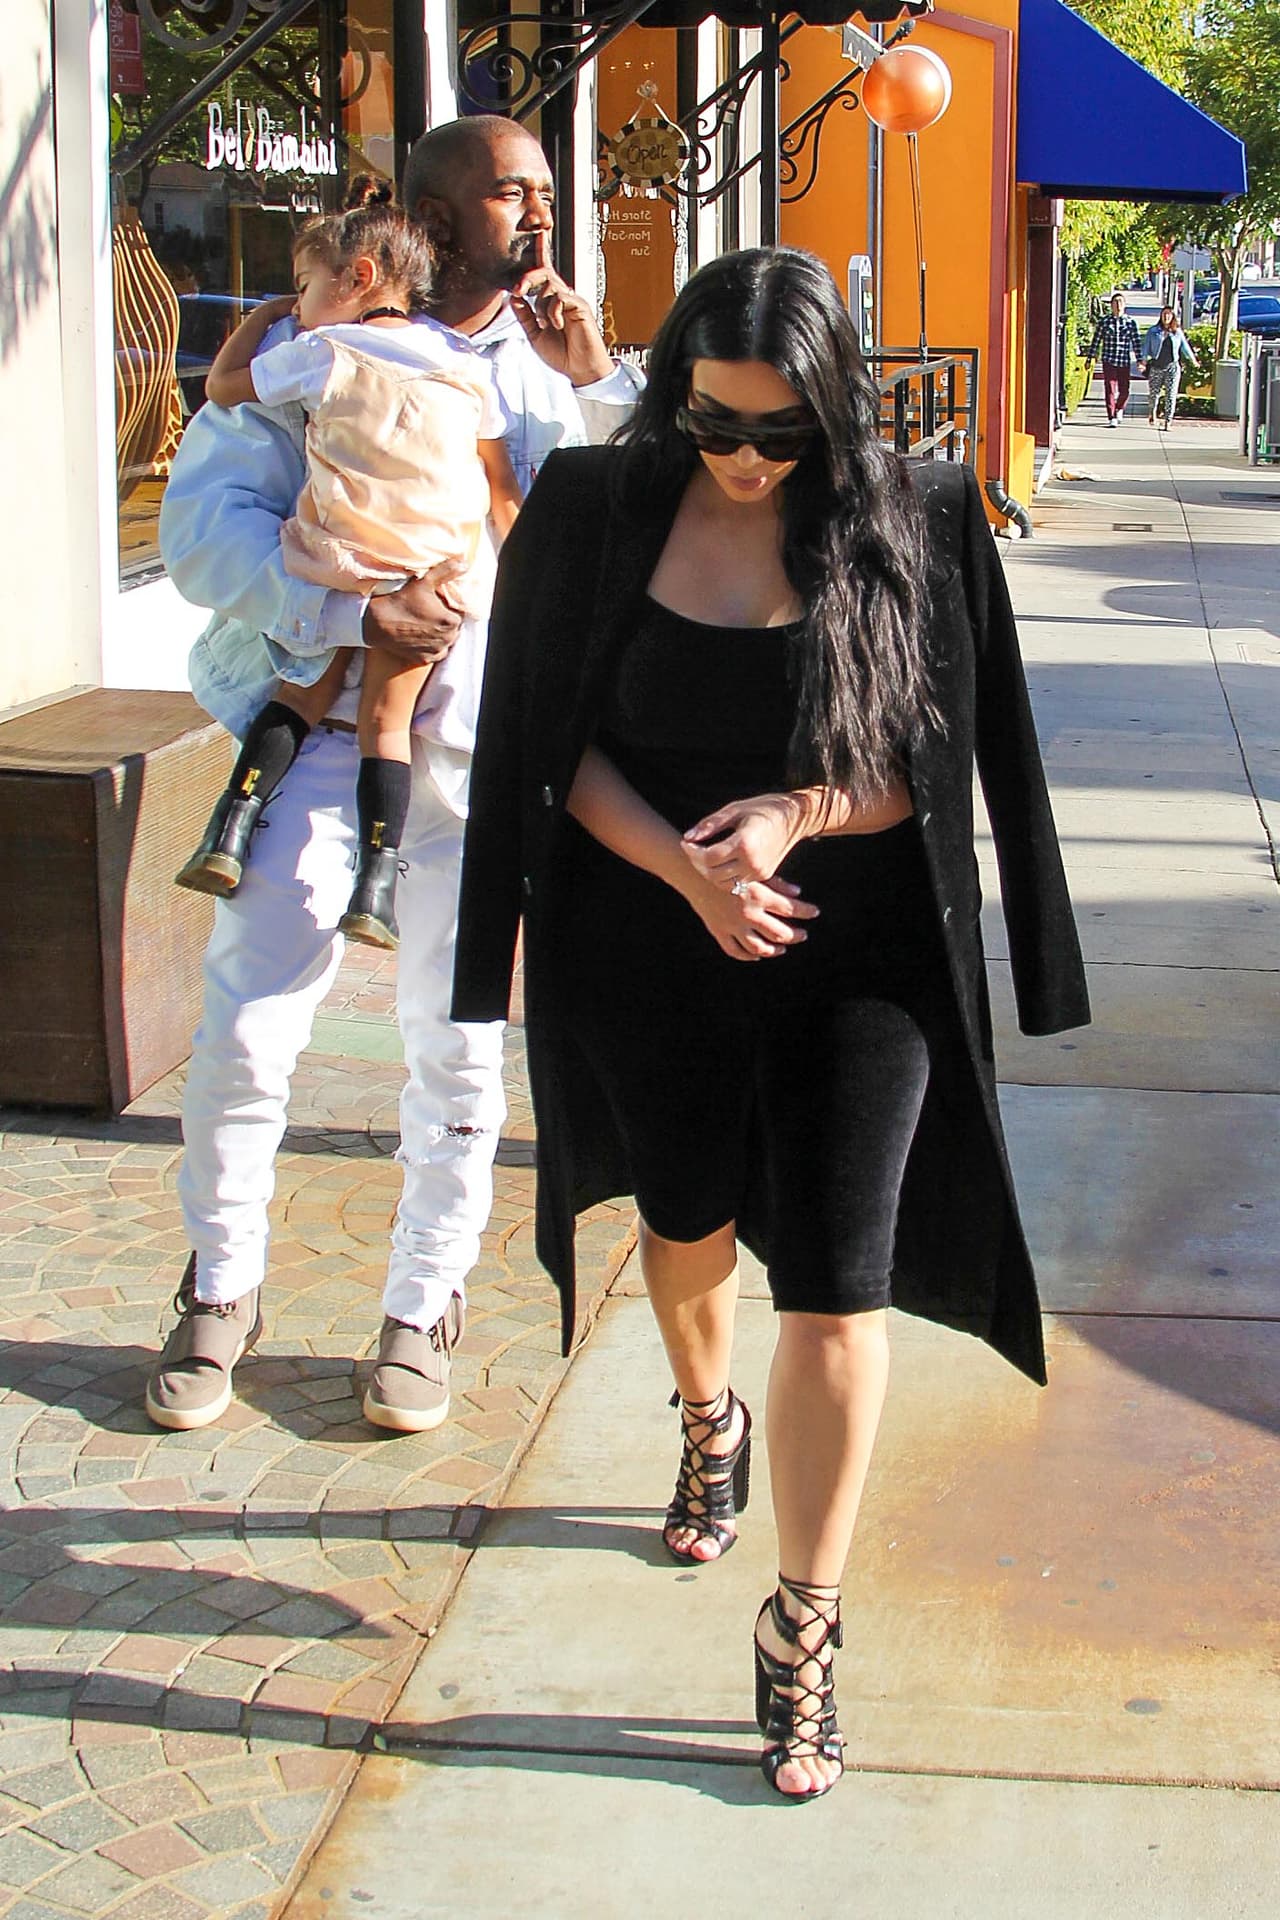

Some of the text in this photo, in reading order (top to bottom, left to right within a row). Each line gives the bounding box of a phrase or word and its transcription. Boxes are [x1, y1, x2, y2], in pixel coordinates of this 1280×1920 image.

[206, 98, 338, 175] Bel Bambini
[627, 144, 668, 170] Open
